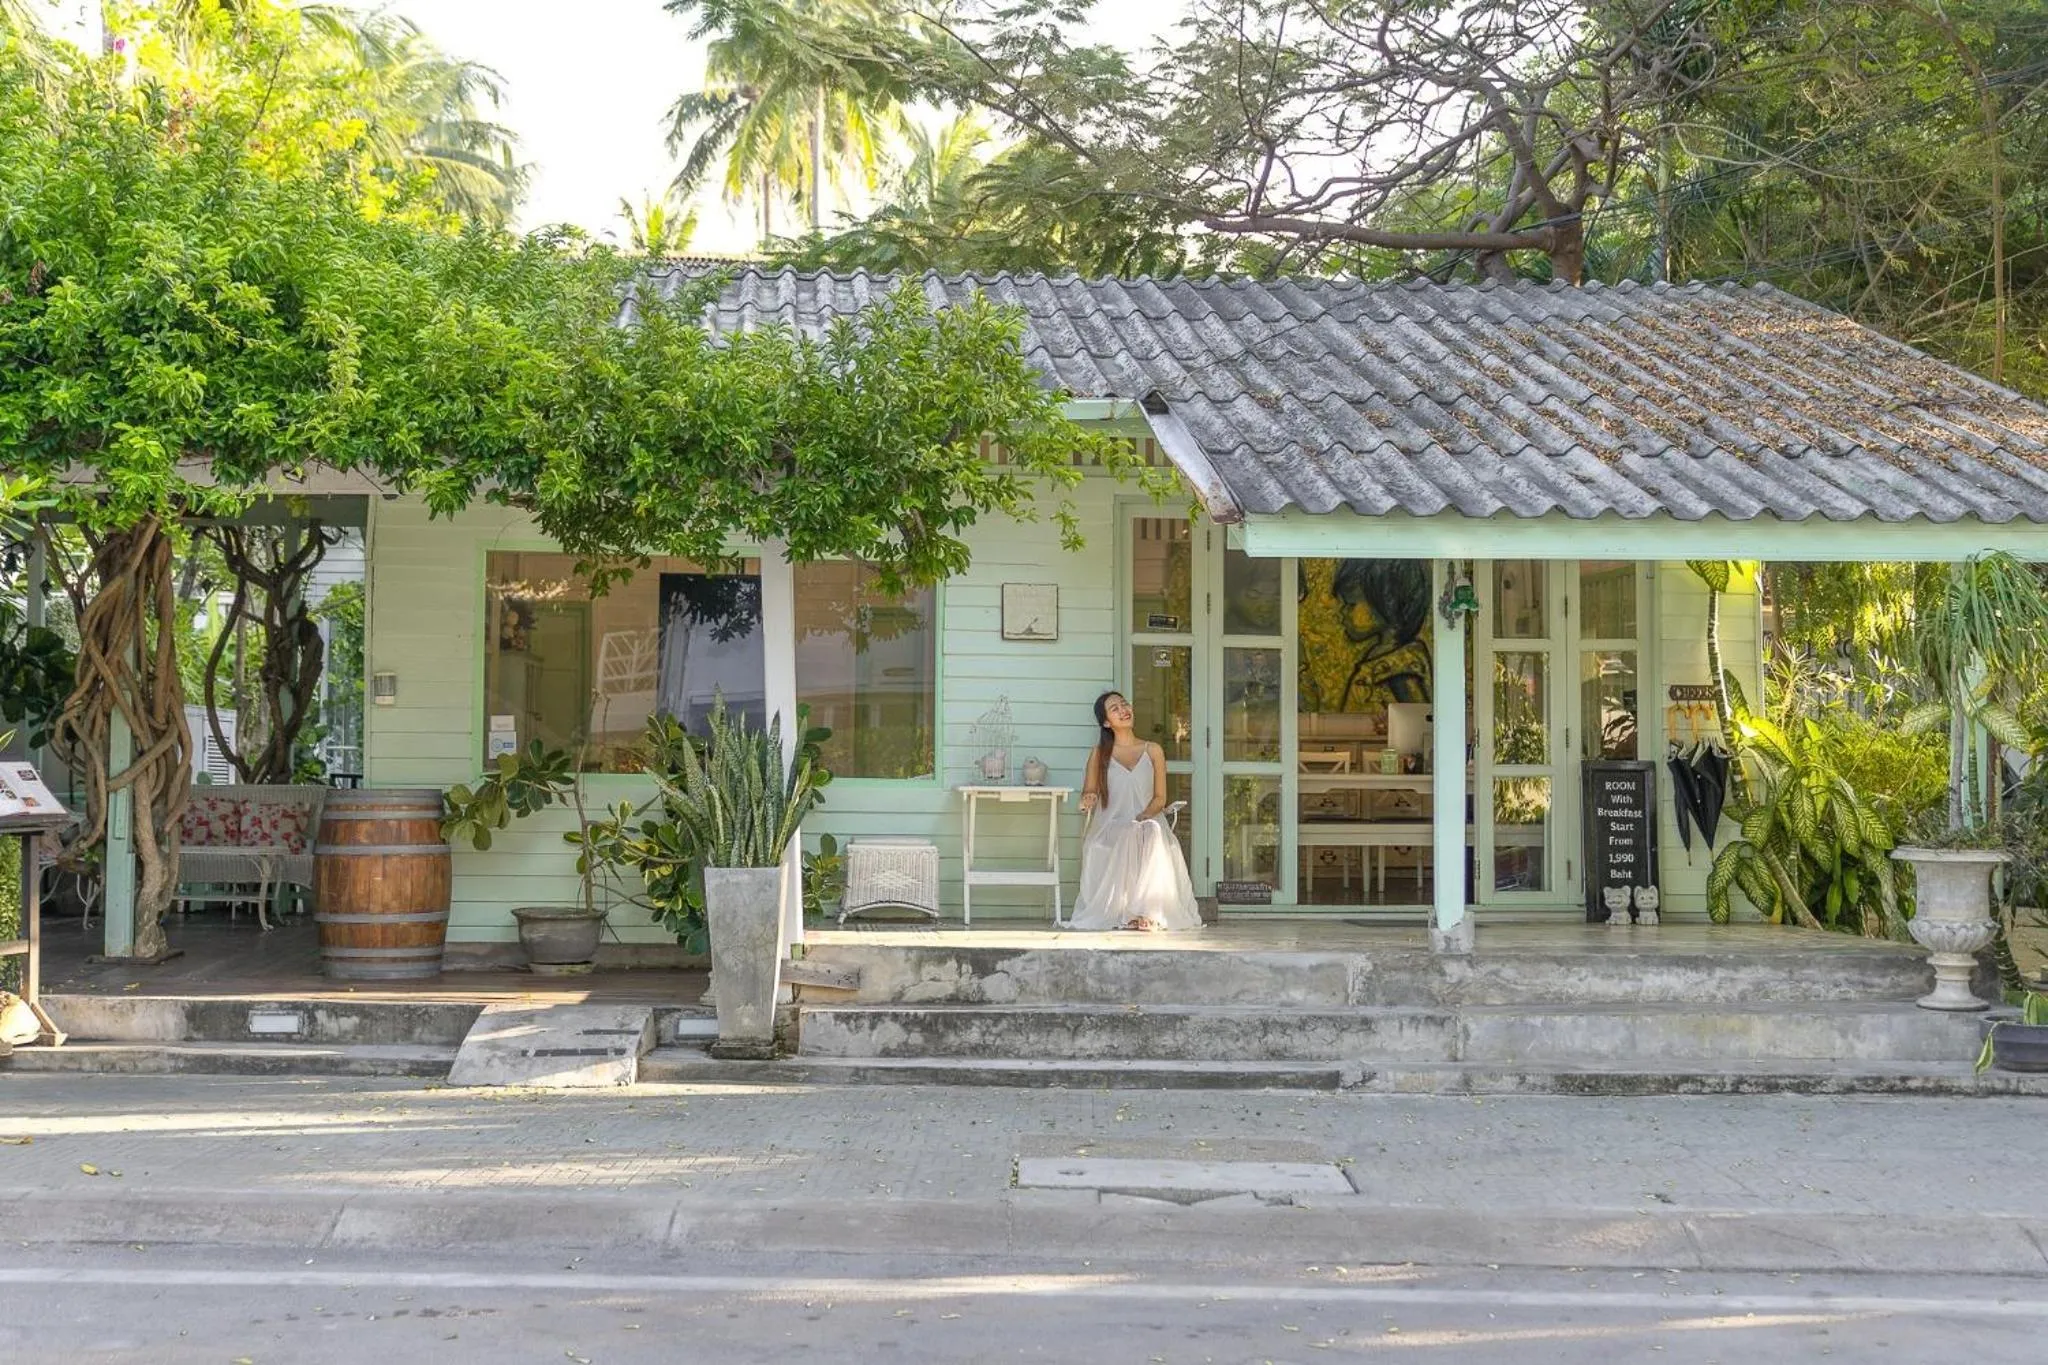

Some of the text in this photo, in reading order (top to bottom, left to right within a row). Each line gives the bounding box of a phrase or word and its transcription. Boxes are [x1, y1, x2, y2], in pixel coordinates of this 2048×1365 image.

[1605, 781, 1636, 791] ROOM
[1611, 794, 1633, 804] With
[1597, 807, 1643, 818] Breakfast
[1610, 821, 1634, 831] Start
[1608, 836, 1633, 846] From
[1608, 853, 1634, 864] 1,990
[1610, 868, 1632, 879] Baht
